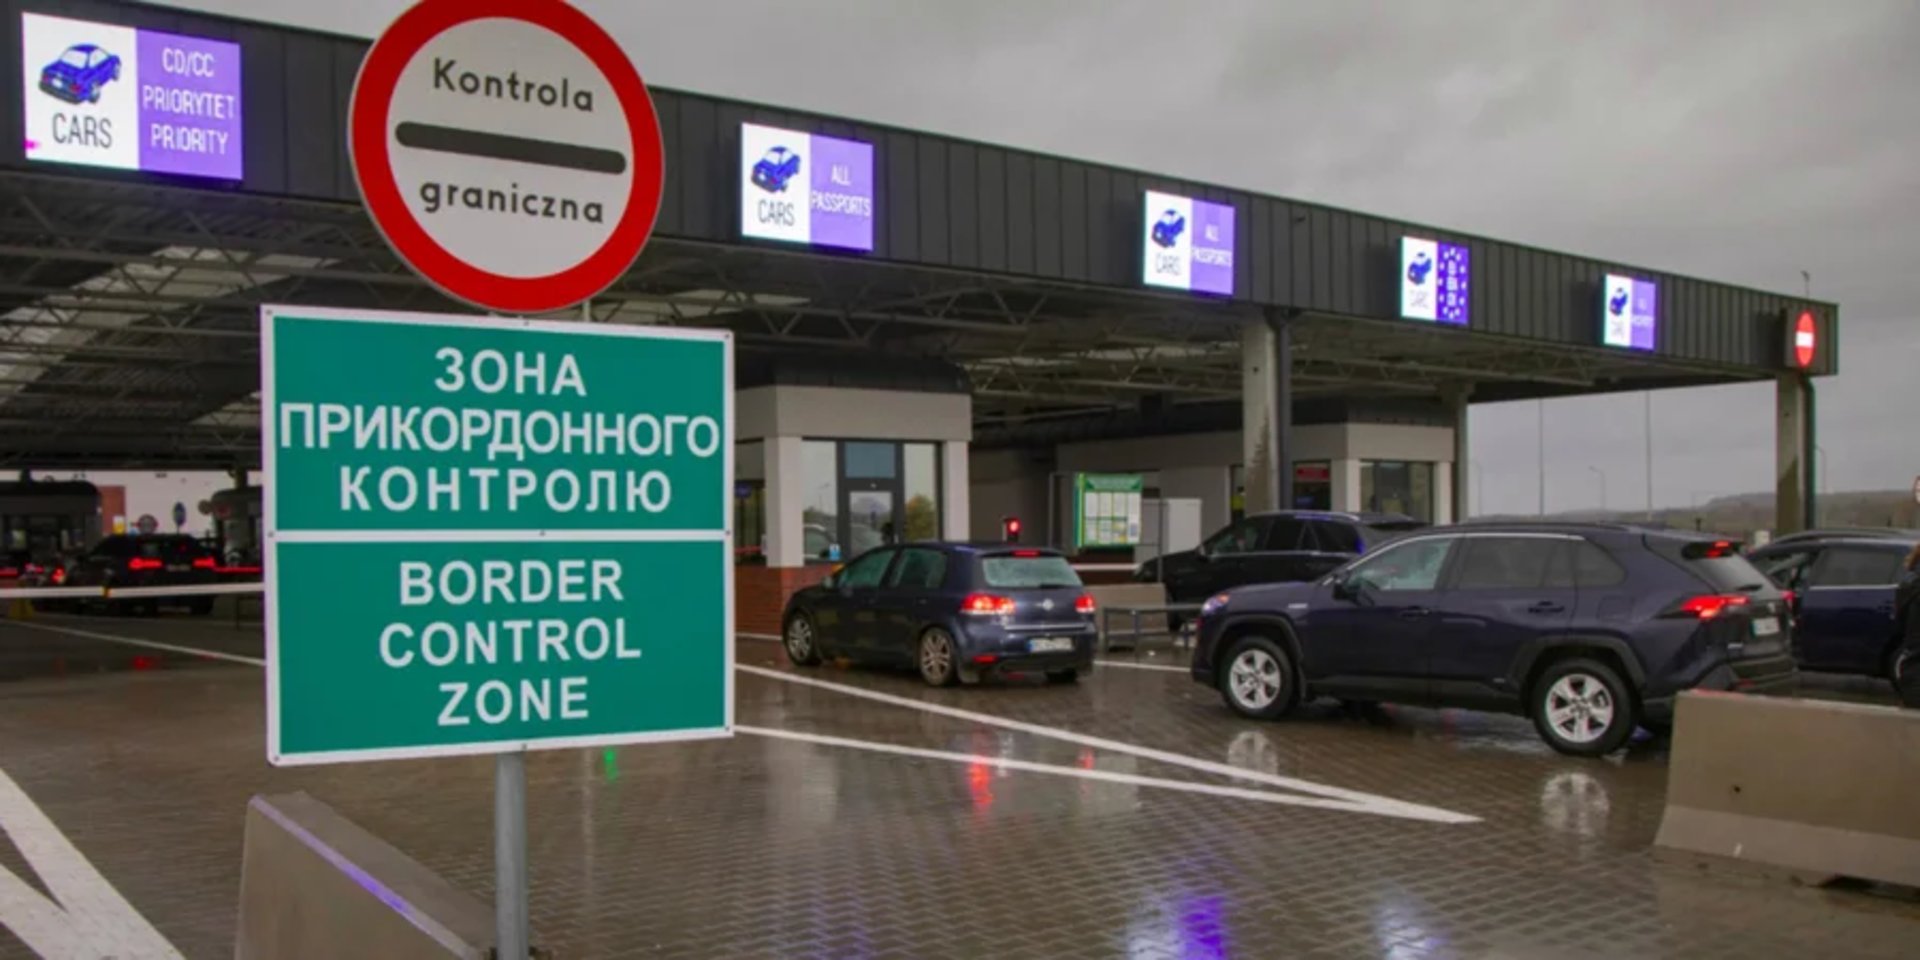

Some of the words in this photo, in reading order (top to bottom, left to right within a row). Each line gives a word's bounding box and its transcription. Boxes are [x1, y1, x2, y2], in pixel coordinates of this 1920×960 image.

[162, 48, 215, 77] CD/CC
[142, 85, 235, 119] PRIORYTET
[433, 57, 594, 112] Kontrola
[52, 112, 113, 149] CARS
[151, 123, 229, 155] PRIORITY
[420, 182, 604, 223] graniczna
[757, 199, 795, 226] CARS
[811, 190, 872, 218] PASSPORTS
[434, 346, 588, 397] ЗОНА
[280, 402, 720, 462] ПРИКОРДОННОГО
[340, 465, 672, 513] КОНТРОЛЮ
[400, 559, 625, 605] BORDER
[379, 617, 642, 668] CONTROL
[437, 676, 589, 726] ZONE
